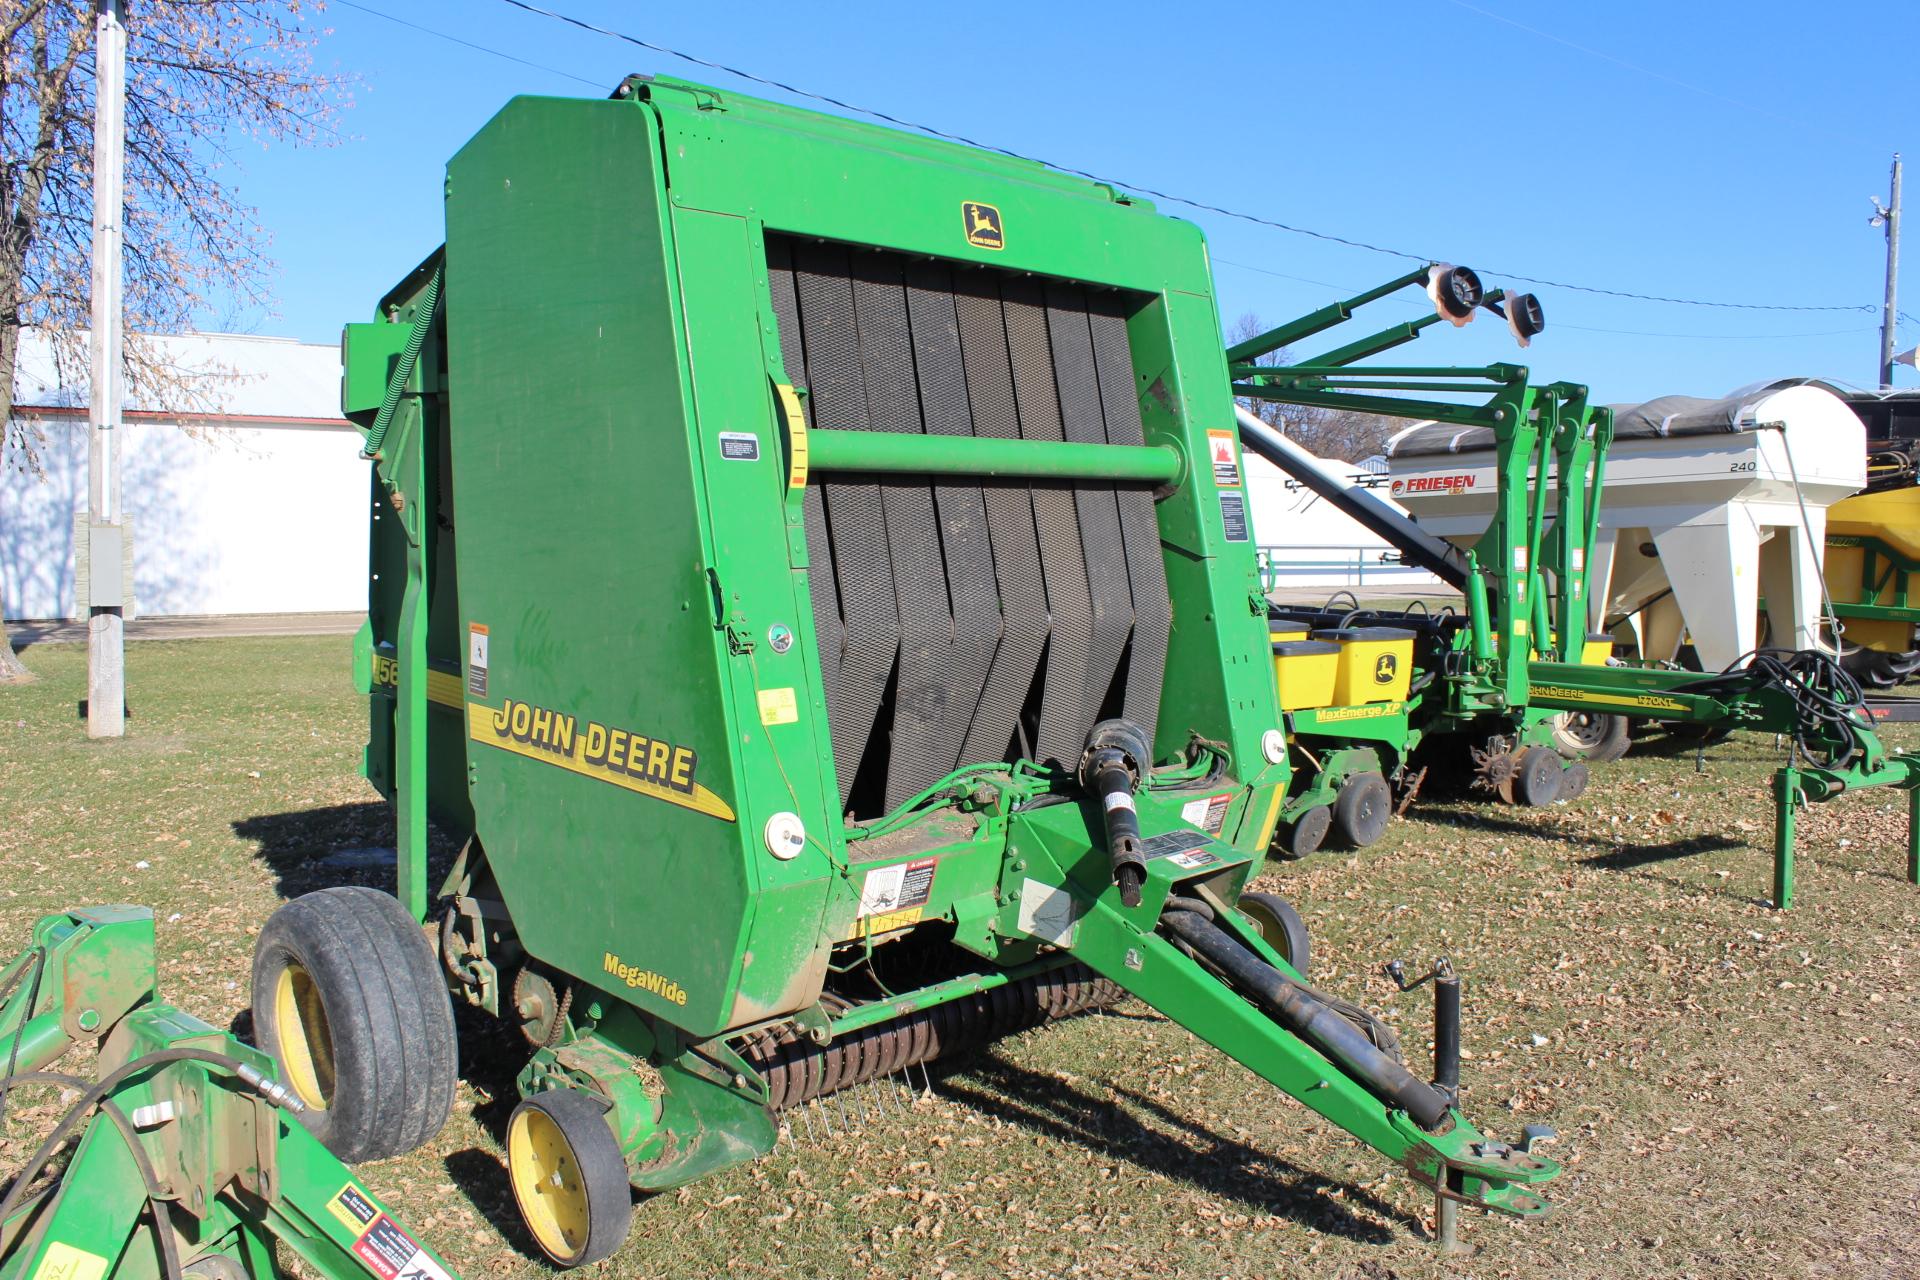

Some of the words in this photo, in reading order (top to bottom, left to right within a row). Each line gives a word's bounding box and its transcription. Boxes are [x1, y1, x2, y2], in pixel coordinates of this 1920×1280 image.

[1731, 462, 1756, 472] 240
[1407, 475, 1476, 491] FRIESEN
[1550, 686, 1584, 699] DEERE
[1316, 706, 1382, 722] MaxEmerge
[1382, 703, 1401, 716] XP
[494, 699, 576, 757] JOHN
[584, 721, 697, 793] DEERE
[604, 951, 687, 1006] MegaWide
[360, 1245, 388, 1272] DANGER
